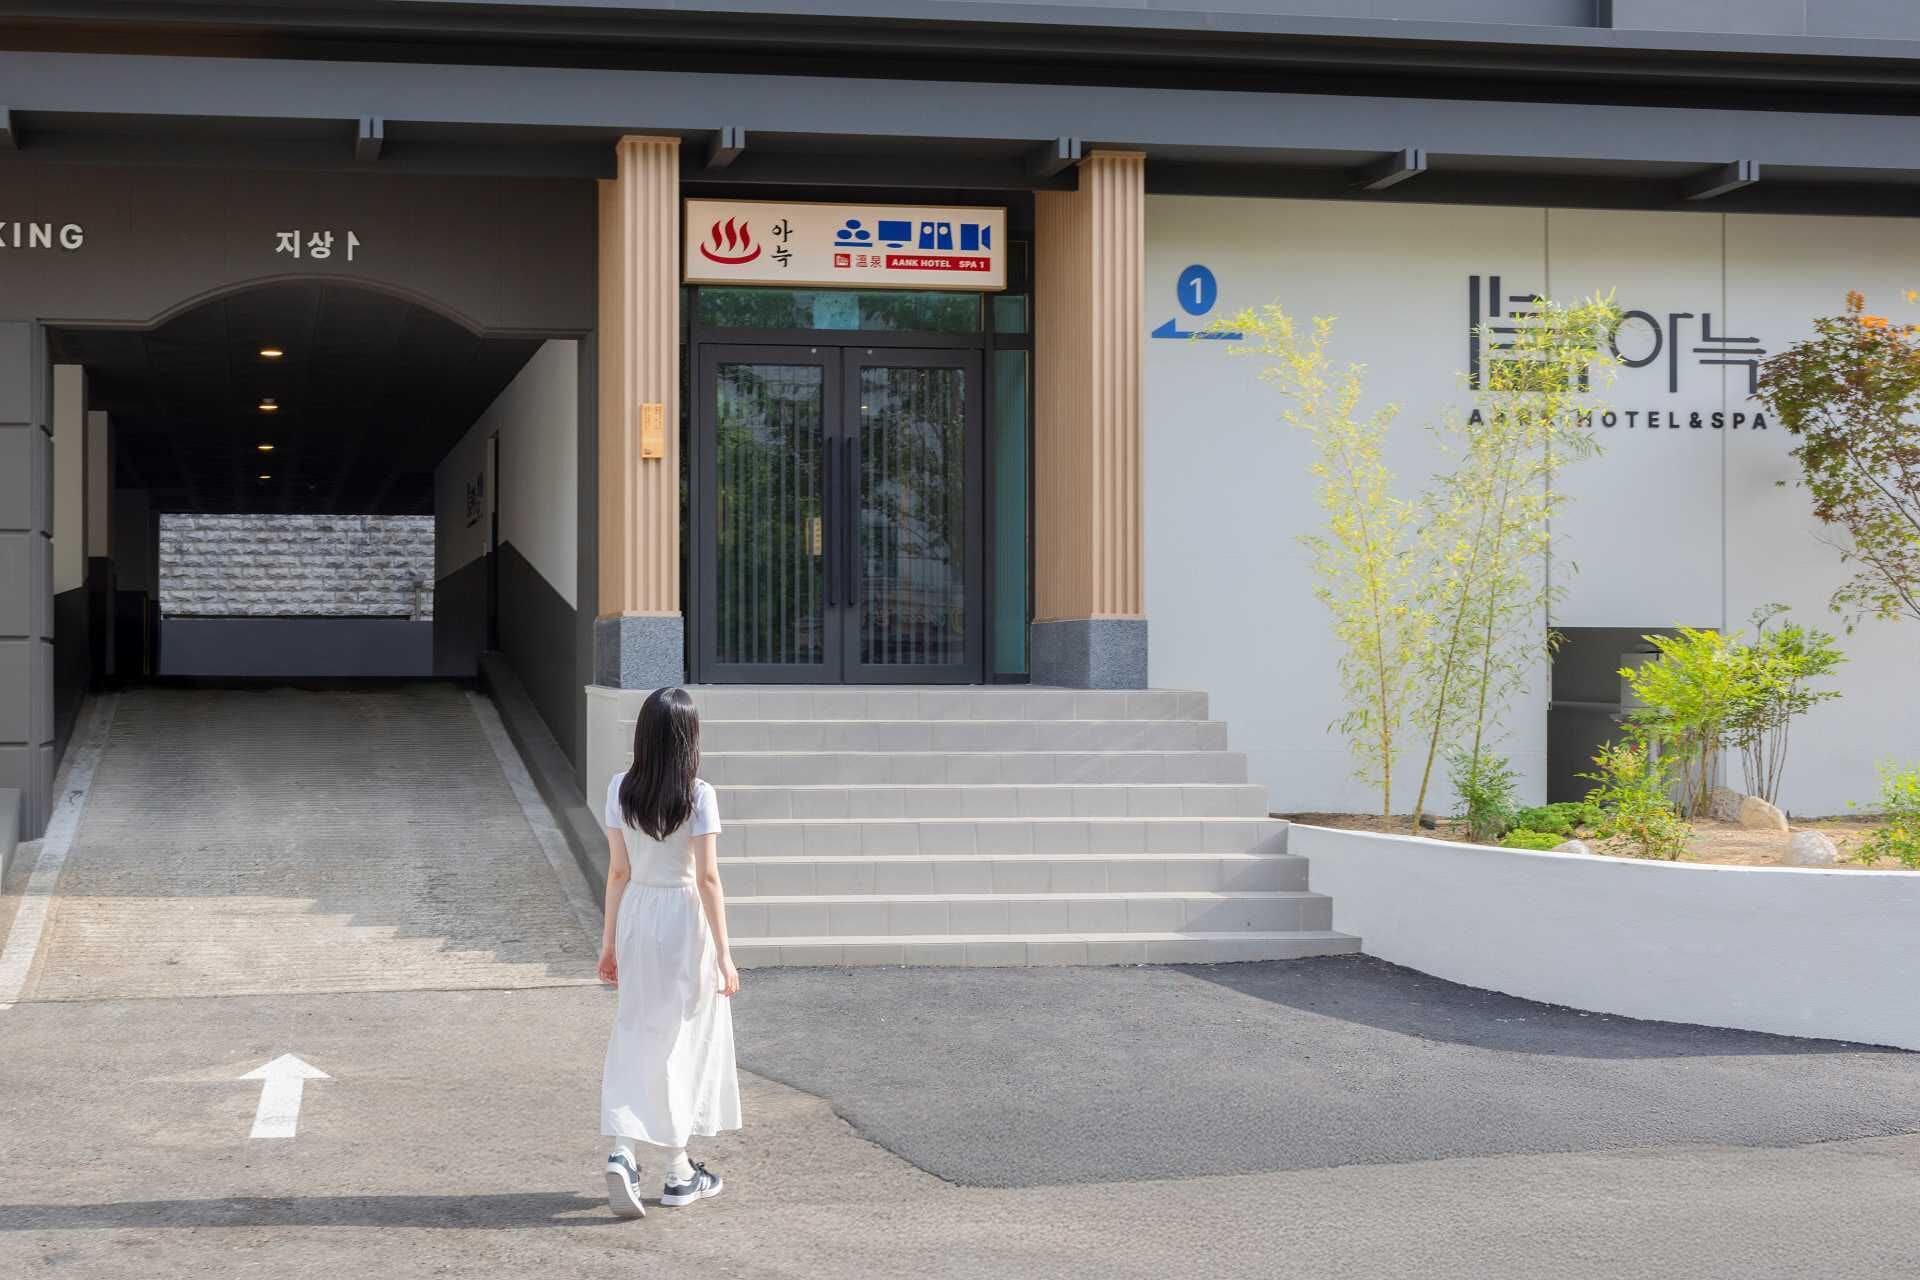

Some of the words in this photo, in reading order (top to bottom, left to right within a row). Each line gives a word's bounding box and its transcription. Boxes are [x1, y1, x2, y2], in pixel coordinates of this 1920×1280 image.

[275, 230, 335, 259] 지상
[771, 218, 793, 268] 아늑
[891, 258, 919, 267] AANK
[920, 259, 951, 268] HOTEL
[957, 260, 977, 269] SPA
[979, 261, 985, 269] 1
[1189, 276, 1202, 305] 1
